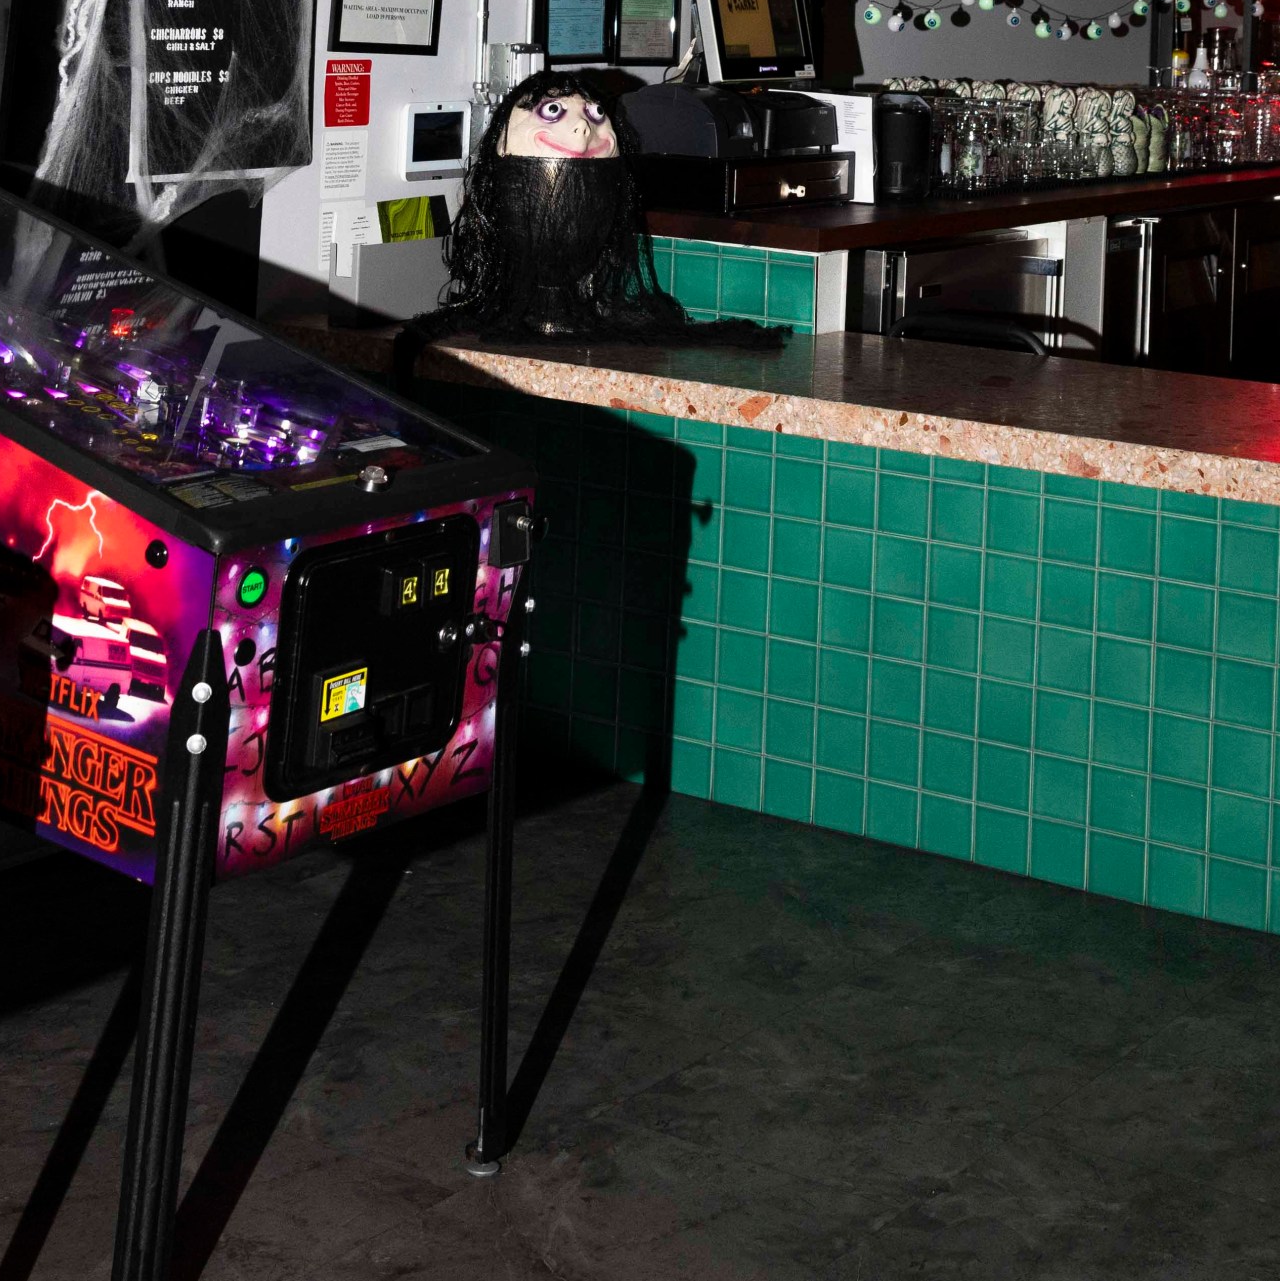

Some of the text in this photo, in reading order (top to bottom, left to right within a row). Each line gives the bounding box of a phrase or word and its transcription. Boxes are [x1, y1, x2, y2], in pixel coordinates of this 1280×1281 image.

[168, 0, 195, 8] RANCH
[151, 28, 224, 40] CHICHARRONS $8
[166, 42, 188, 51] CHILI
[195, 41, 215, 51] SALT
[332, 64, 365, 72] WARNING:
[149, 71, 171, 84] CUPS
[219, 70, 230, 83] $3
[165, 85, 199, 94] CHICKEN
[164, 96, 186, 106] BEEF
[242, 582, 263, 593] START
[436, 574, 444, 589] 4
[404, 582, 412, 597] 4
[50, 673, 101, 721] TFLIX
[45, 726, 157, 826] NGER
[41, 777, 119, 851] NGS
